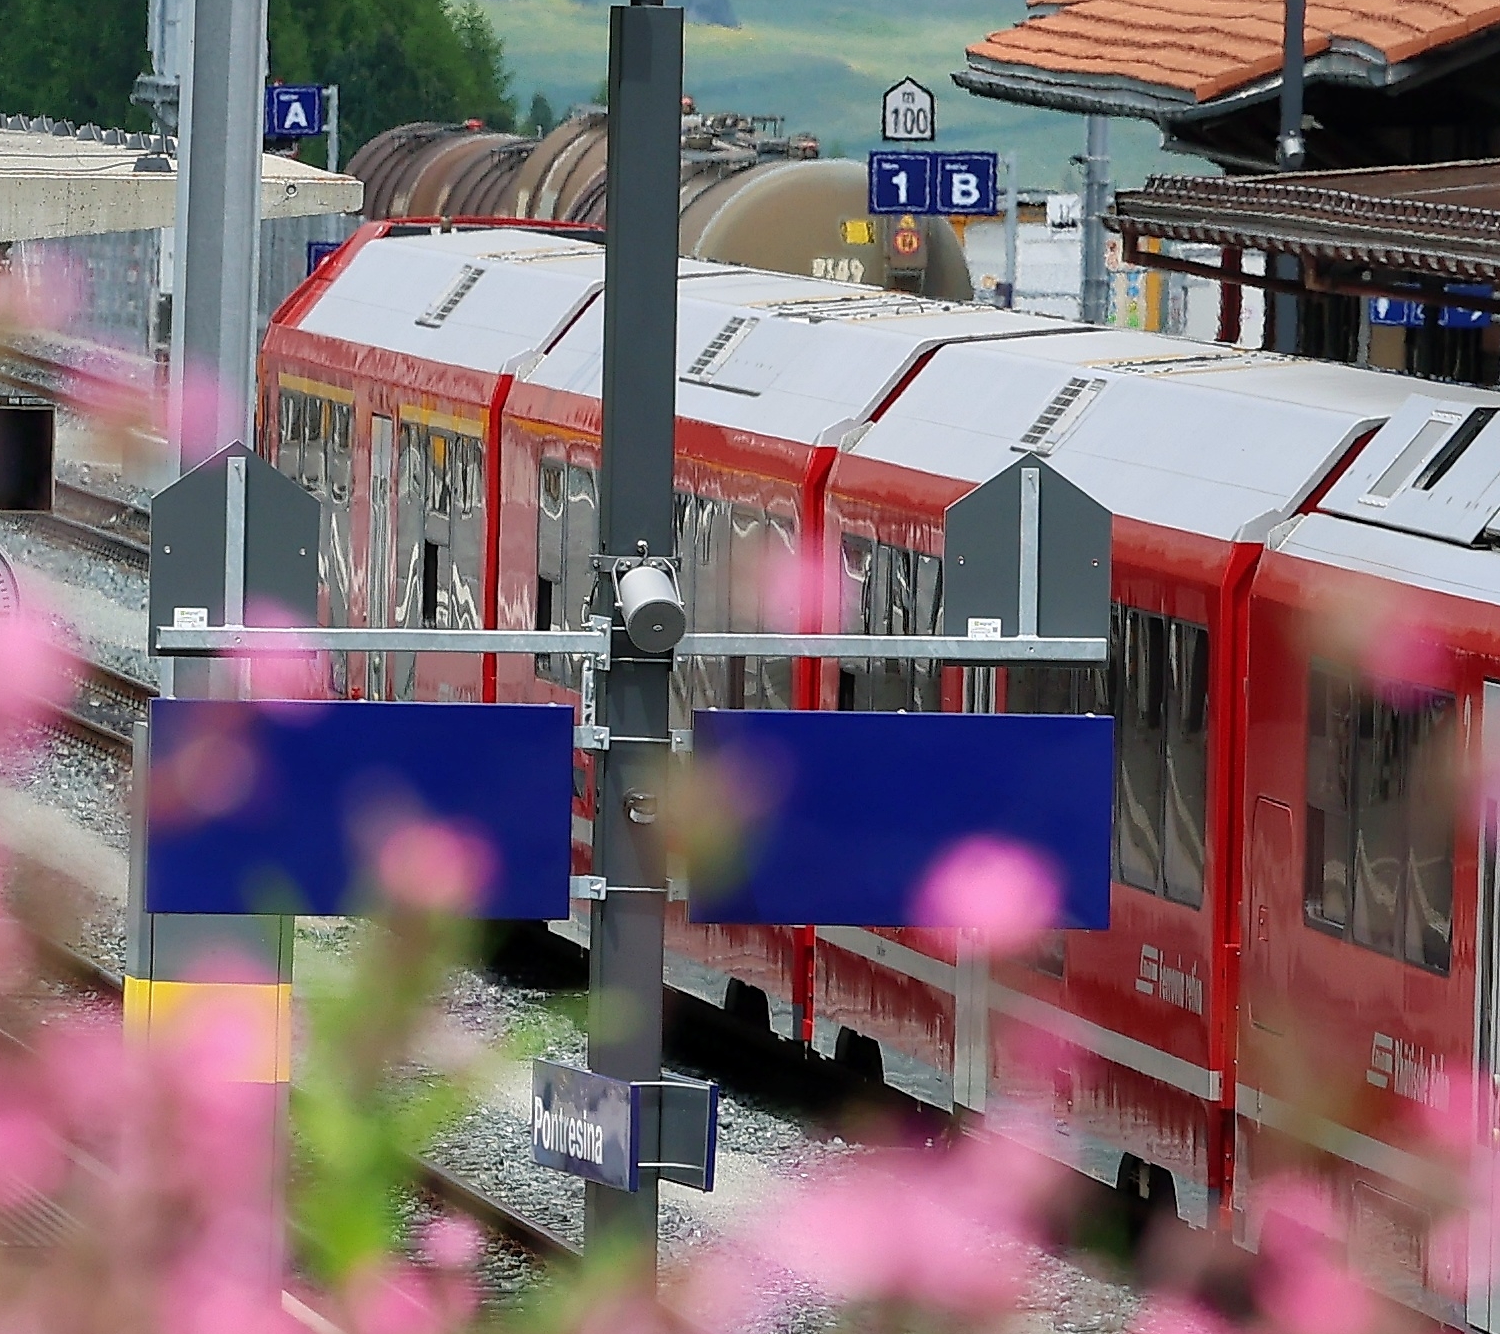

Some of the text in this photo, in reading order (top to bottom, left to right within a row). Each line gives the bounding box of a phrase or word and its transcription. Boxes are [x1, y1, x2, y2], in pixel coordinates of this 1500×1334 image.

[284, 101, 308, 129] A
[891, 108, 928, 134] 100
[892, 171, 908, 204] 1
[951, 172, 981, 206] B
[534, 1096, 603, 1164] Pontresina
